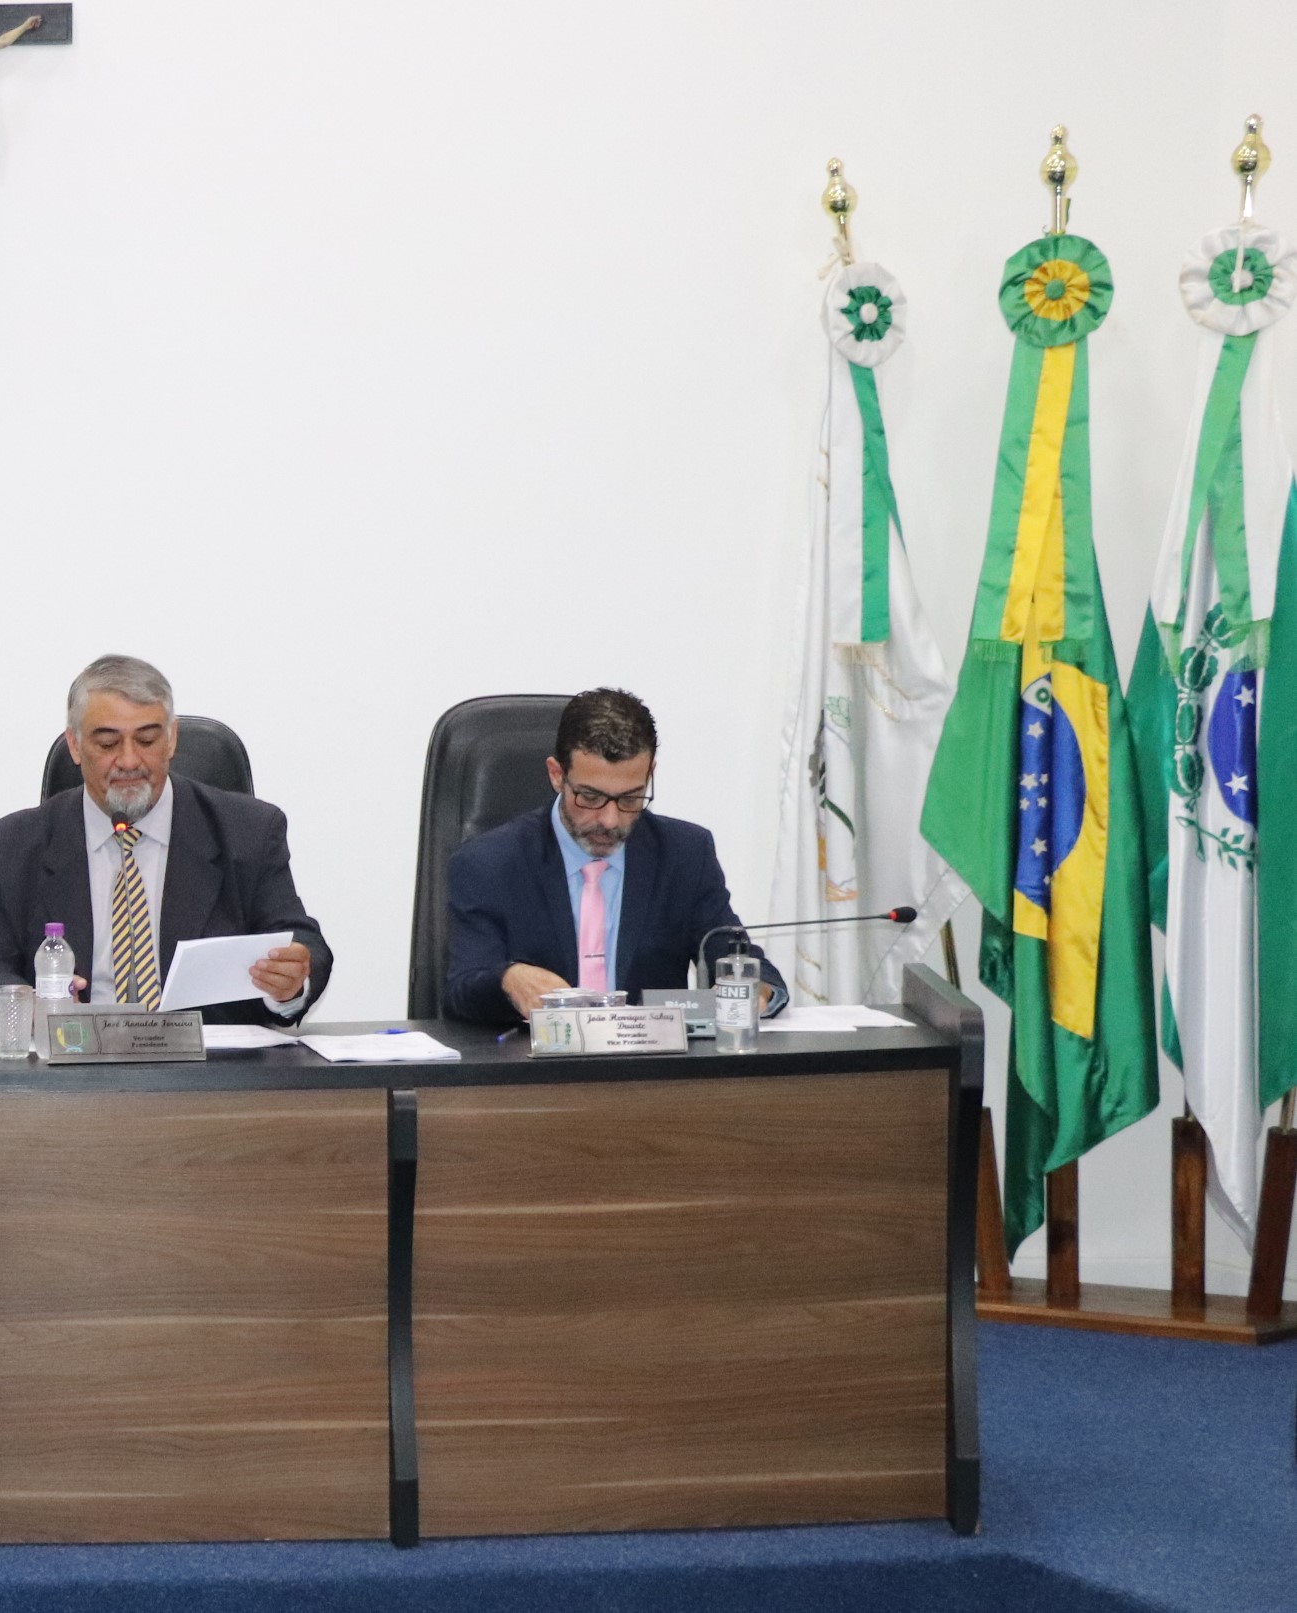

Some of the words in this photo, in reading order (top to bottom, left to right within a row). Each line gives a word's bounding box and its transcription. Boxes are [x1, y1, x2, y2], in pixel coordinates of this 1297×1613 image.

[609, 1013, 646, 1023] Henrique
[123, 1019, 158, 1027] Ronaldo
[617, 1022, 645, 1030] Duarte
